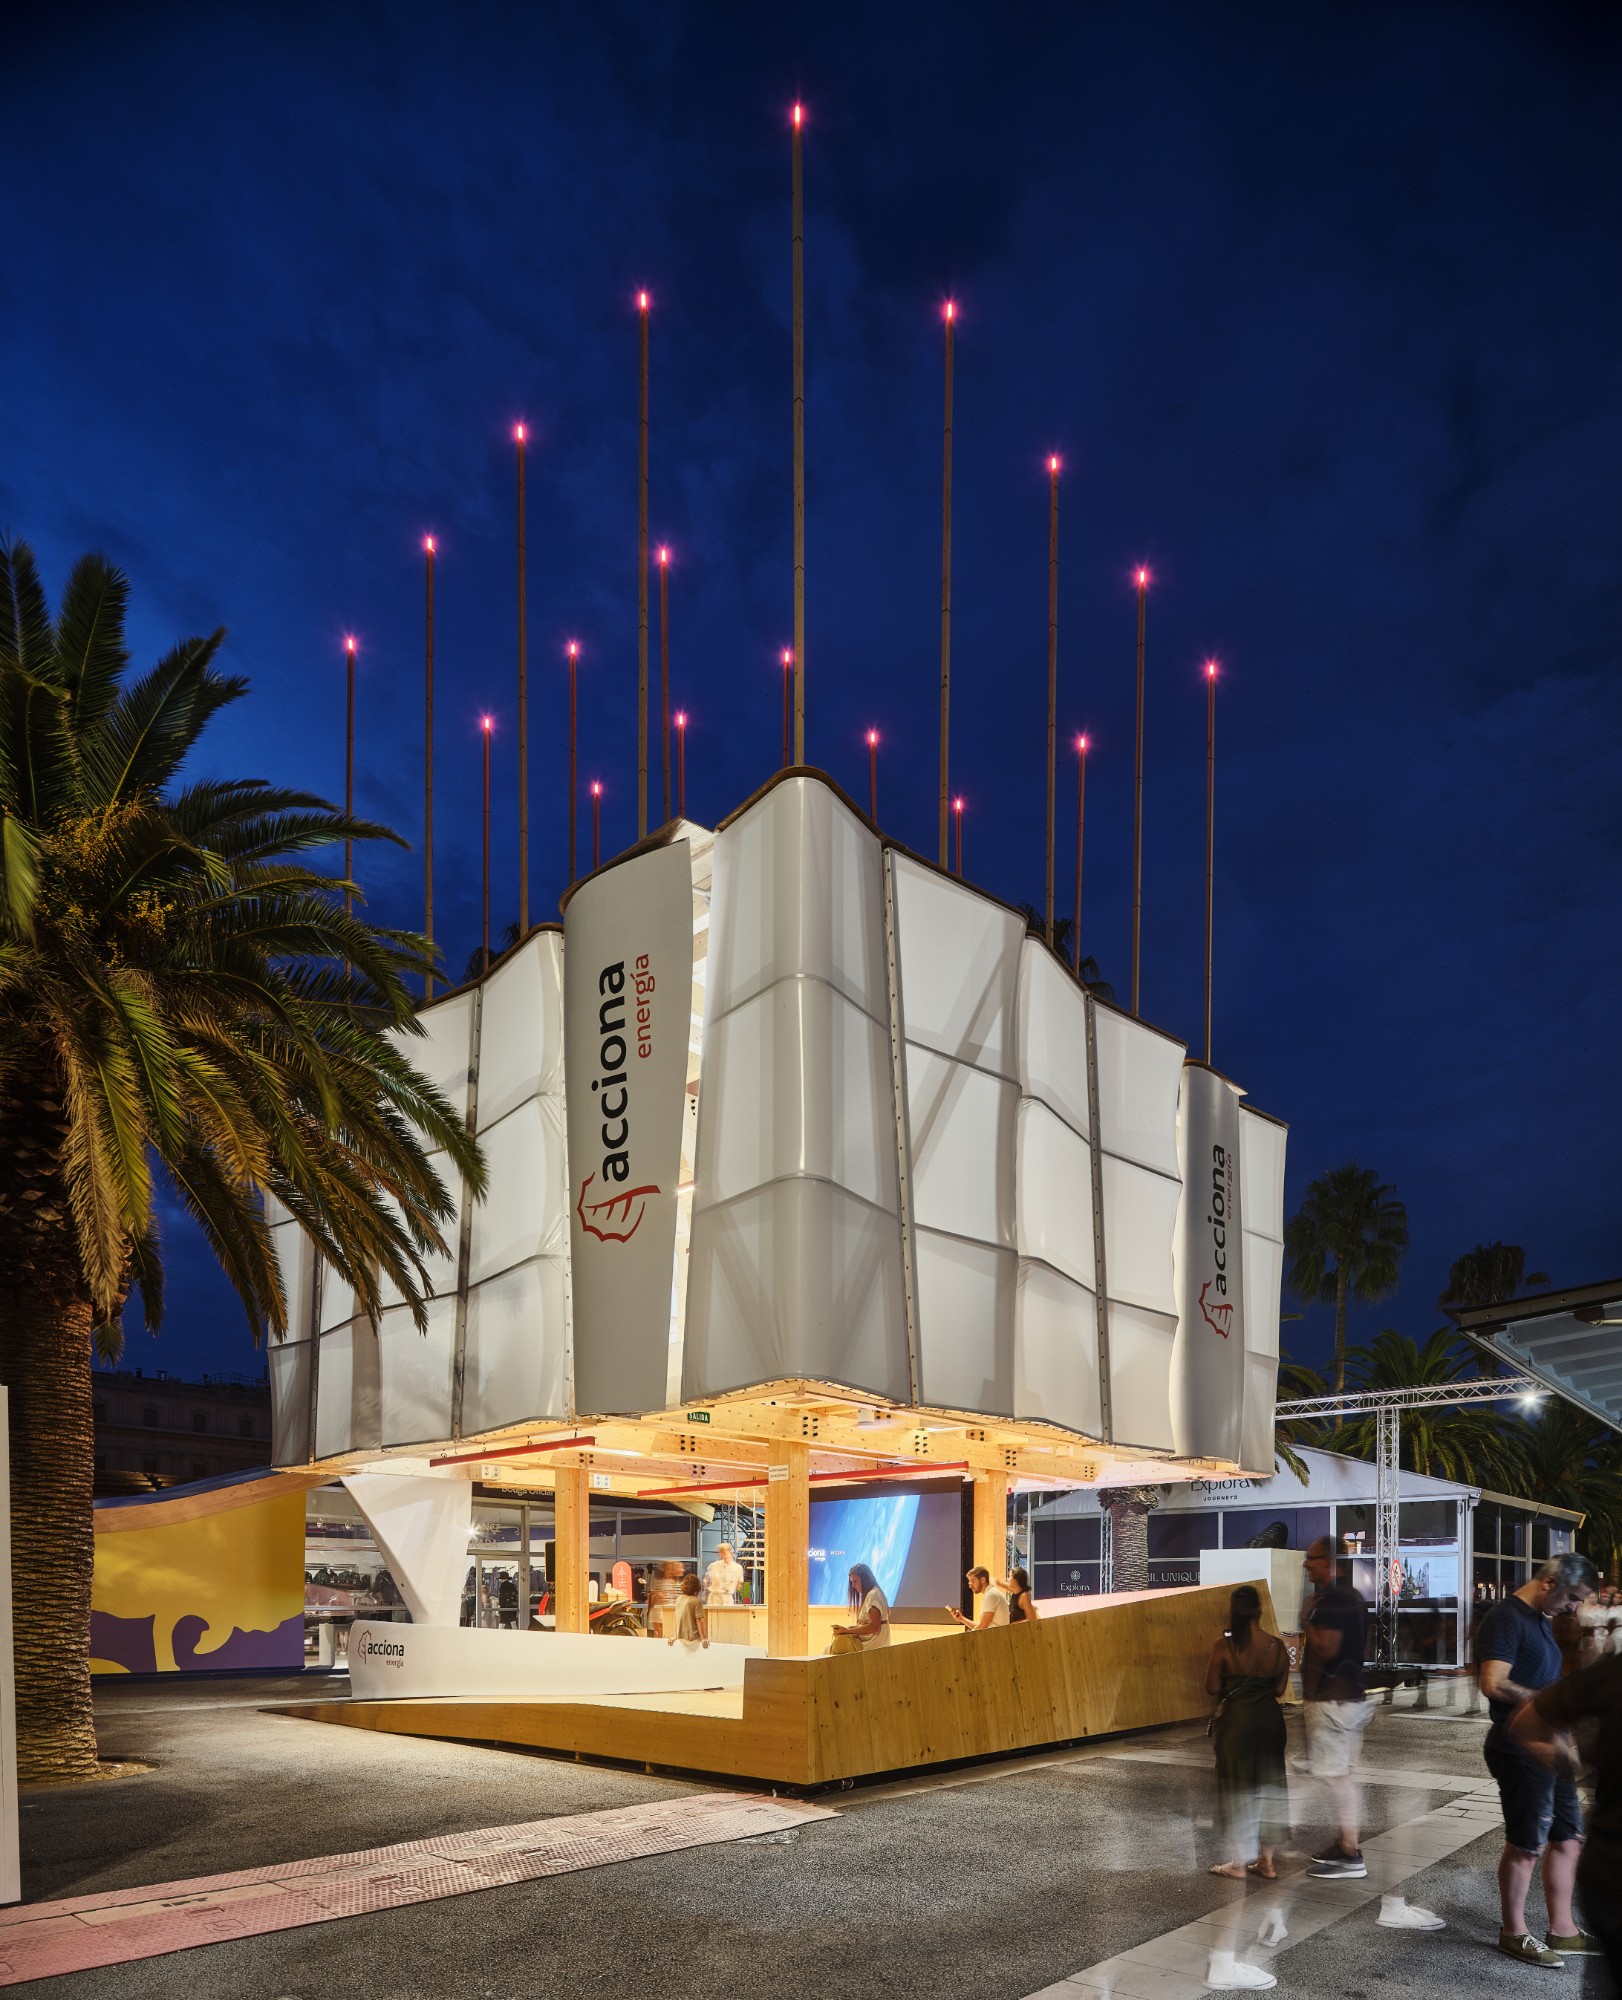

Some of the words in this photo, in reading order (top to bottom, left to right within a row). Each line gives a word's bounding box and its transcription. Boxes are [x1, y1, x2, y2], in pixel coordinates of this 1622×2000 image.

[630, 953, 656, 1059] energía
[591, 960, 630, 1183] acciona
[1225, 1153, 1233, 1221] energía
[1207, 1144, 1227, 1296] acciona
[689, 1412, 708, 1421] SALIDA
[808, 1548, 825, 1556] ciona
[1060, 1582, 1090, 1592] Explora
[367, 1638, 405, 1657] acciona
